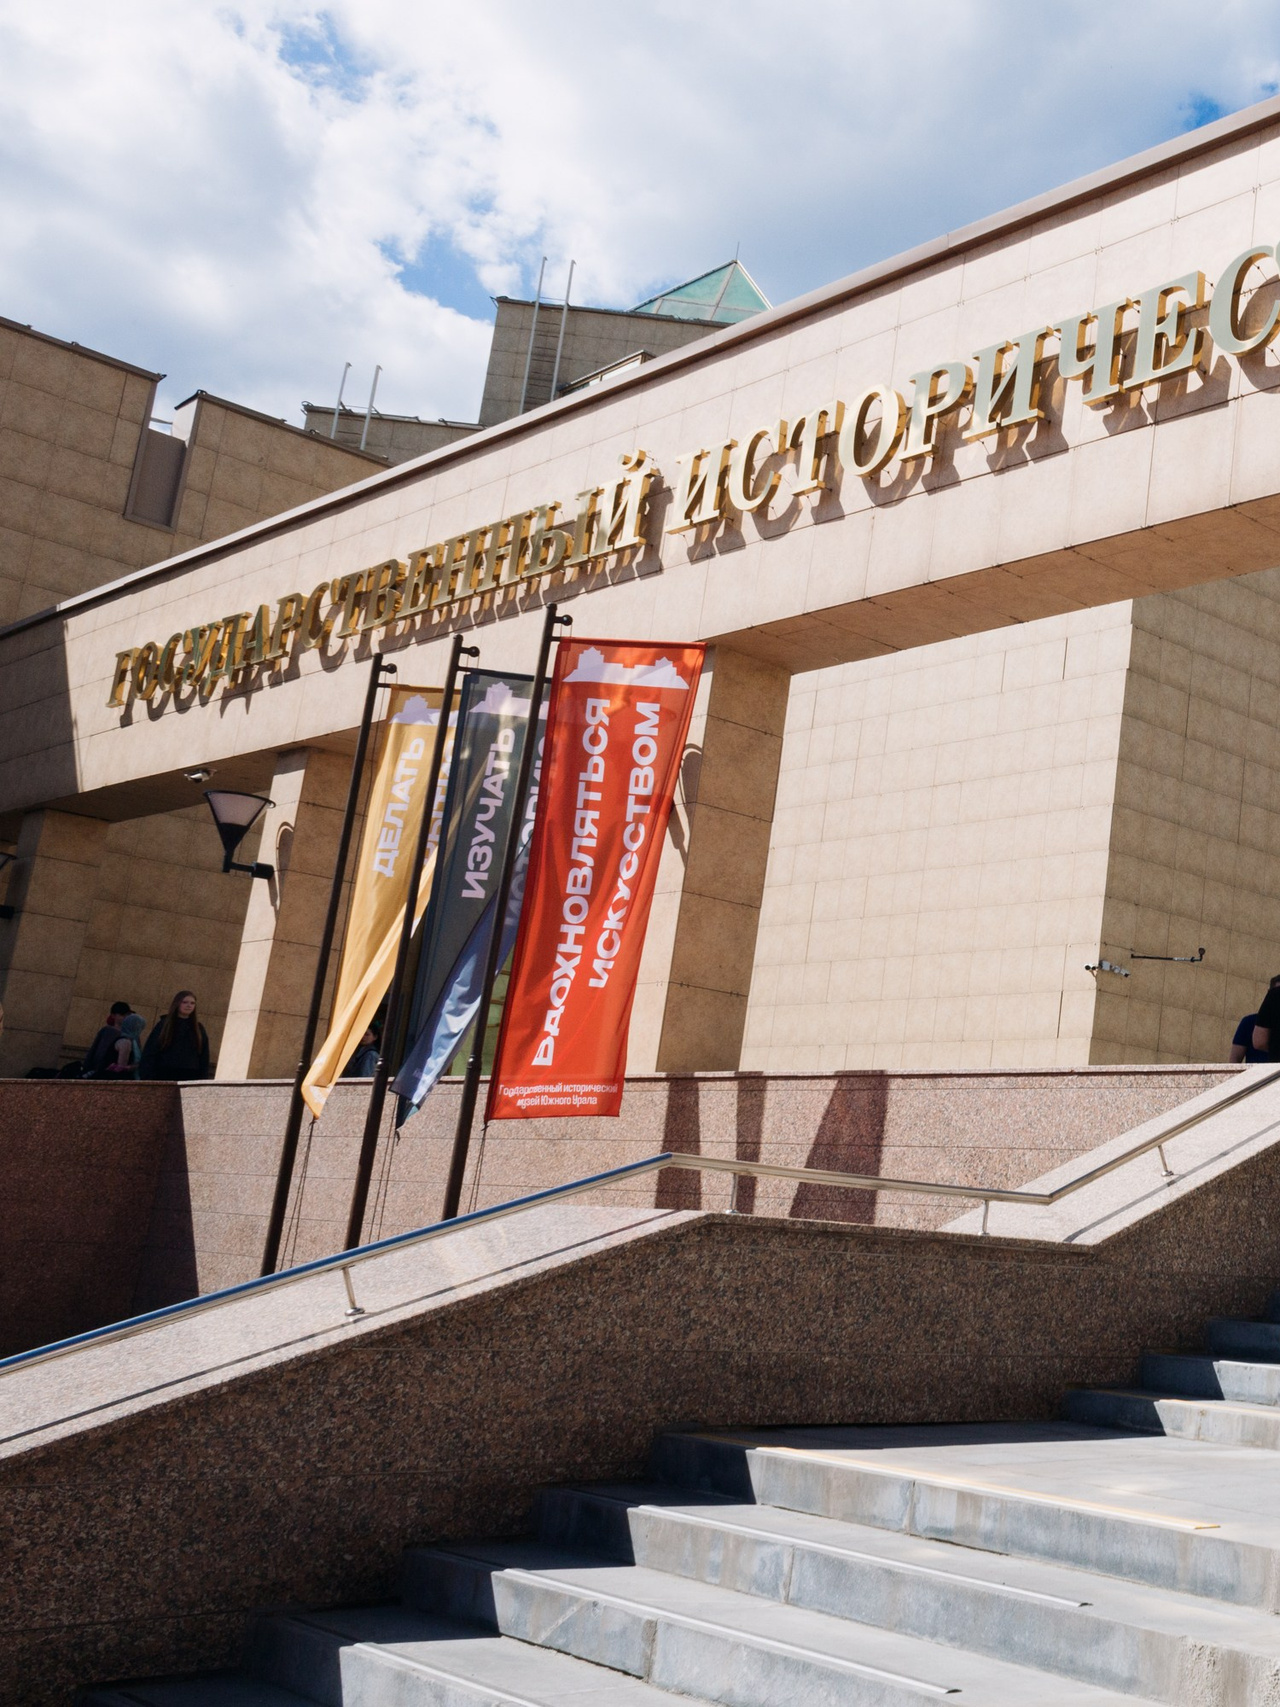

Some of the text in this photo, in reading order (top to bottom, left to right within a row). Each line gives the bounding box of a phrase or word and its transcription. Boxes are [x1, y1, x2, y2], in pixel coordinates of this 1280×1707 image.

[105, 448, 657, 708] ГОСУДАРСТВЕННЫЙ
[372, 736, 426, 878] ДЕЛАТЬ
[461, 728, 516, 899] ИЗУЧАТЬ
[531, 697, 611, 1067] ВДОХНОВЛЯТЬСЯ
[588, 702, 661, 989] ИСКУССТВОМ
[541, 1095, 571, 1106] Южного
[572, 1093, 597, 1107] Урала
